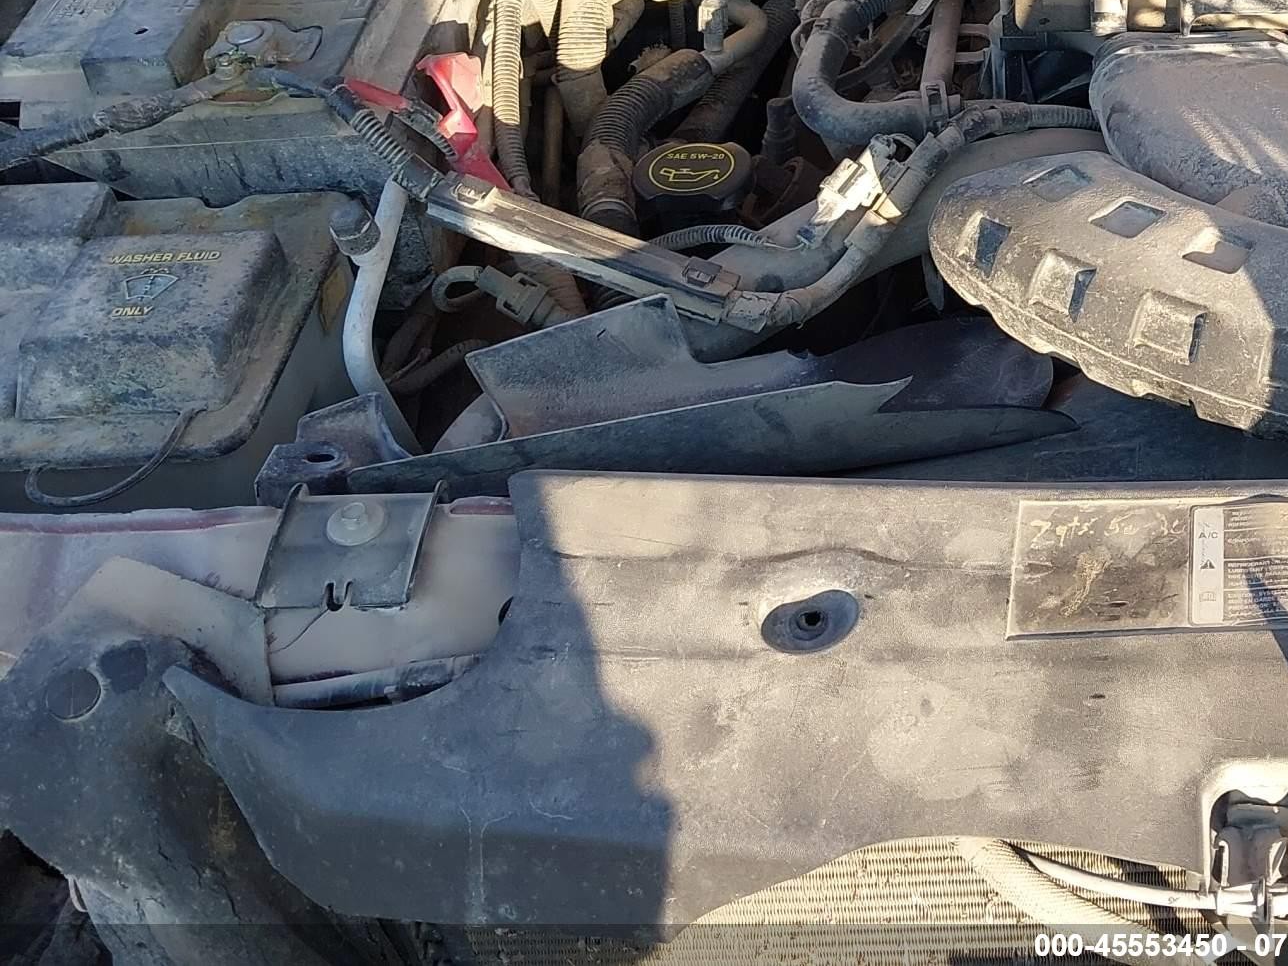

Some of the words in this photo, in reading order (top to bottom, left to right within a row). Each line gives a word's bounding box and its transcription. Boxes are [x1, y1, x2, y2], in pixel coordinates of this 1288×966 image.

[110, 253, 173, 264] WASHER
[176, 251, 221, 262] FLUID
[111, 305, 154, 317] ONLY
[1198, 531, 1219, 539] A/C
